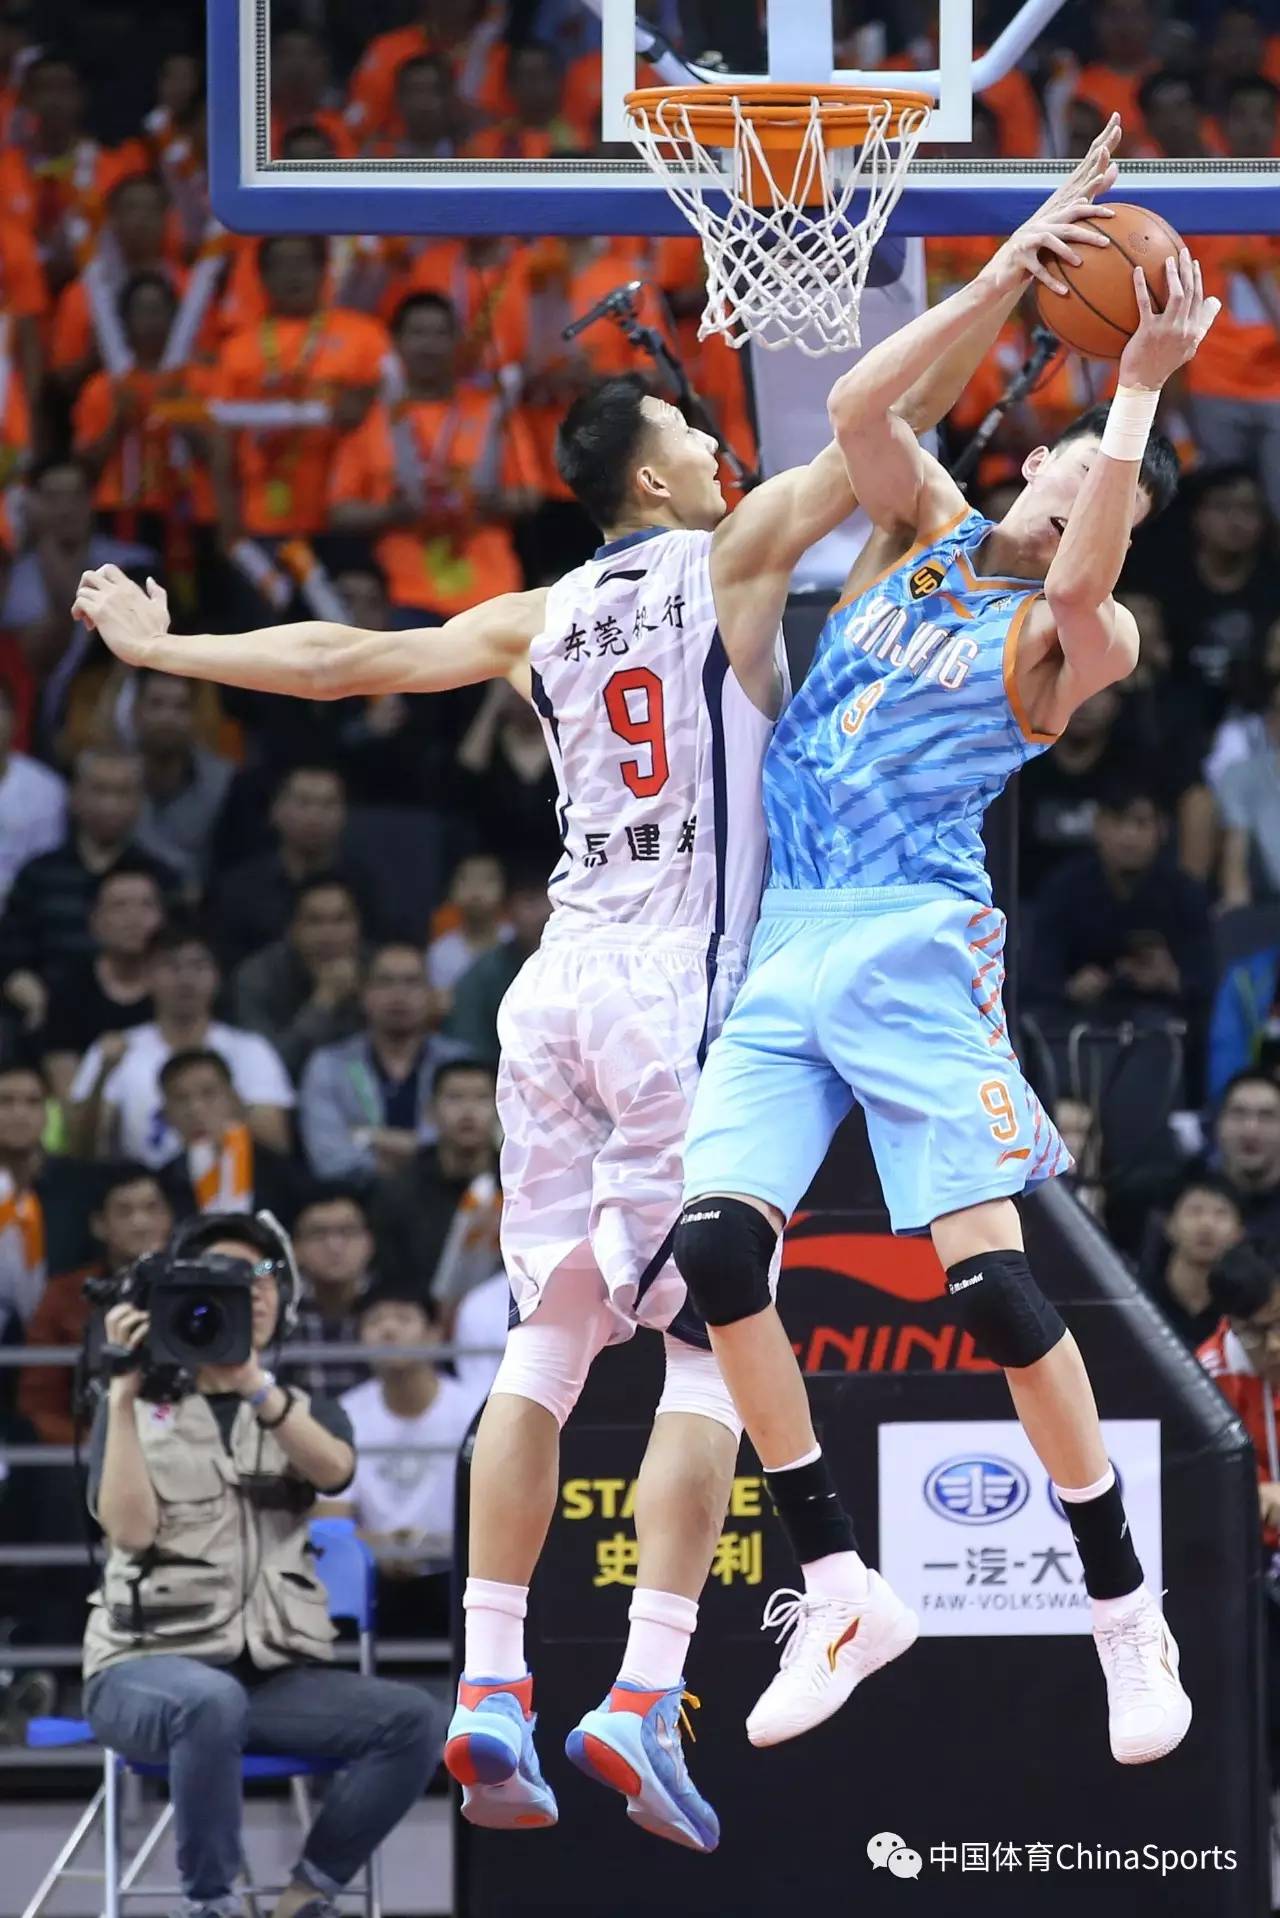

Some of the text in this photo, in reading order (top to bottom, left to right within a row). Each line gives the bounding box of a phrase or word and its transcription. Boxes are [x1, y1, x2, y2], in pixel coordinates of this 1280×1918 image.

[602, 666, 670, 799] 9
[978, 1078, 1019, 1144] 9
[592, 1531, 764, 1587] 史利
[922, 1547, 1086, 1586] 一汽-大
